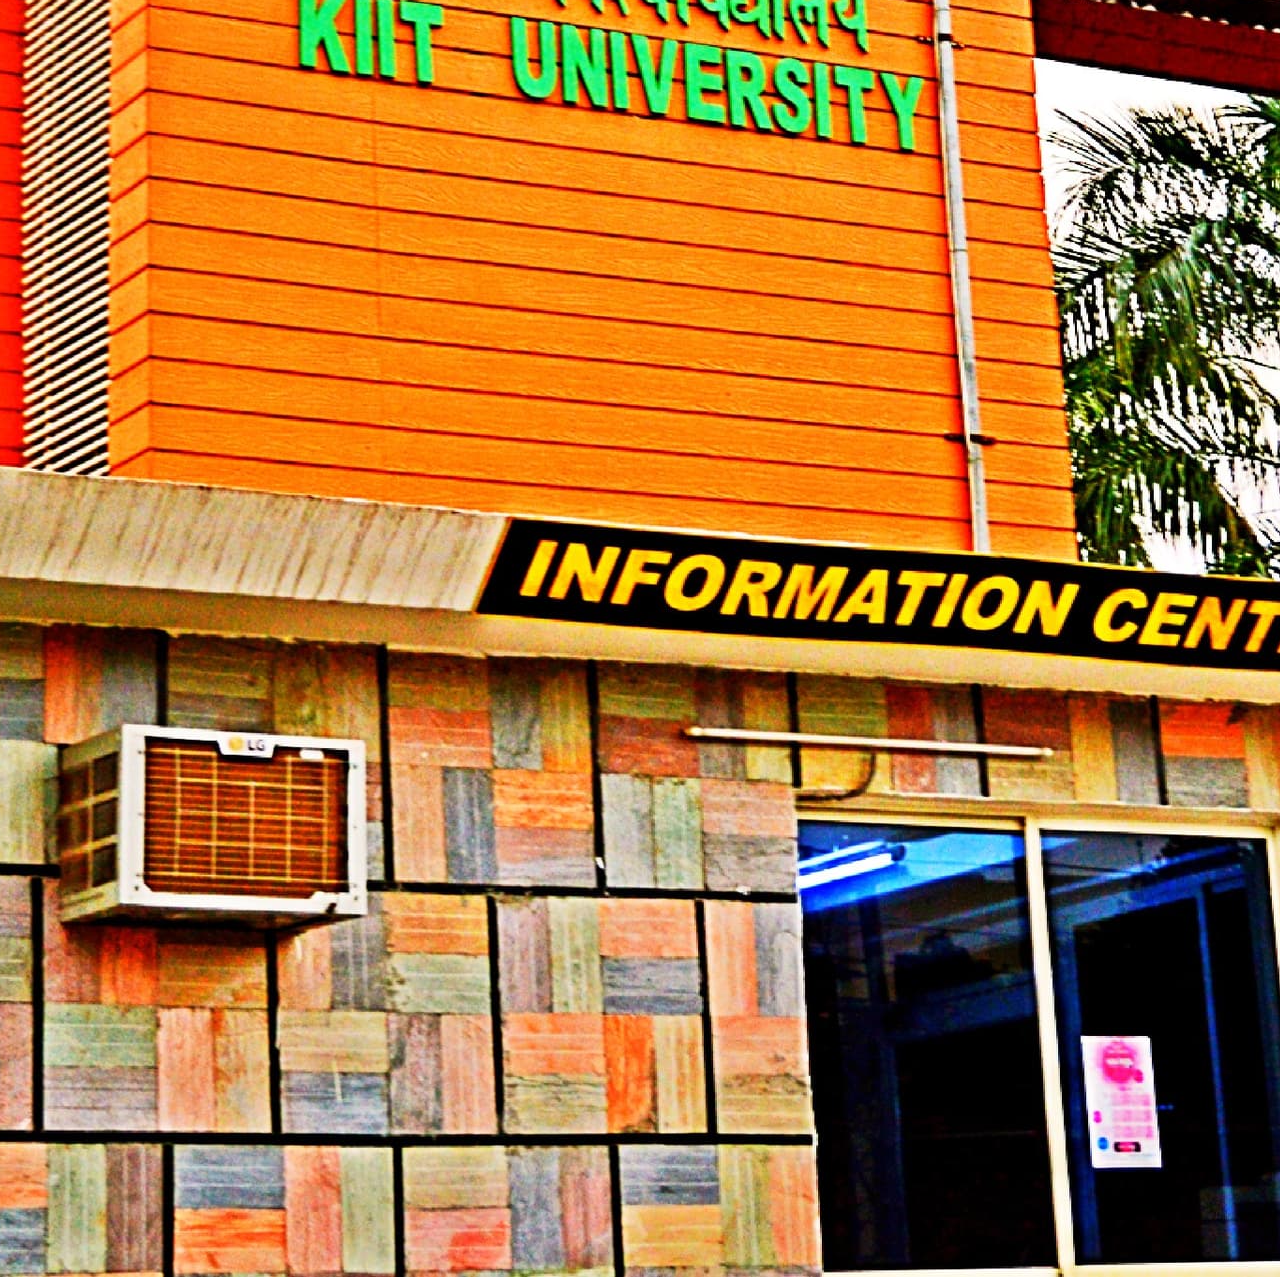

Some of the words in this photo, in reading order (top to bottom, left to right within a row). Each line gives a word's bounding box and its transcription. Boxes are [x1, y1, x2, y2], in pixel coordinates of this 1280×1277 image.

[511, 17, 923, 152] UNIVERSITY
[520, 540, 1079, 637] INFORMATION
[248, 739, 265, 751] LG
